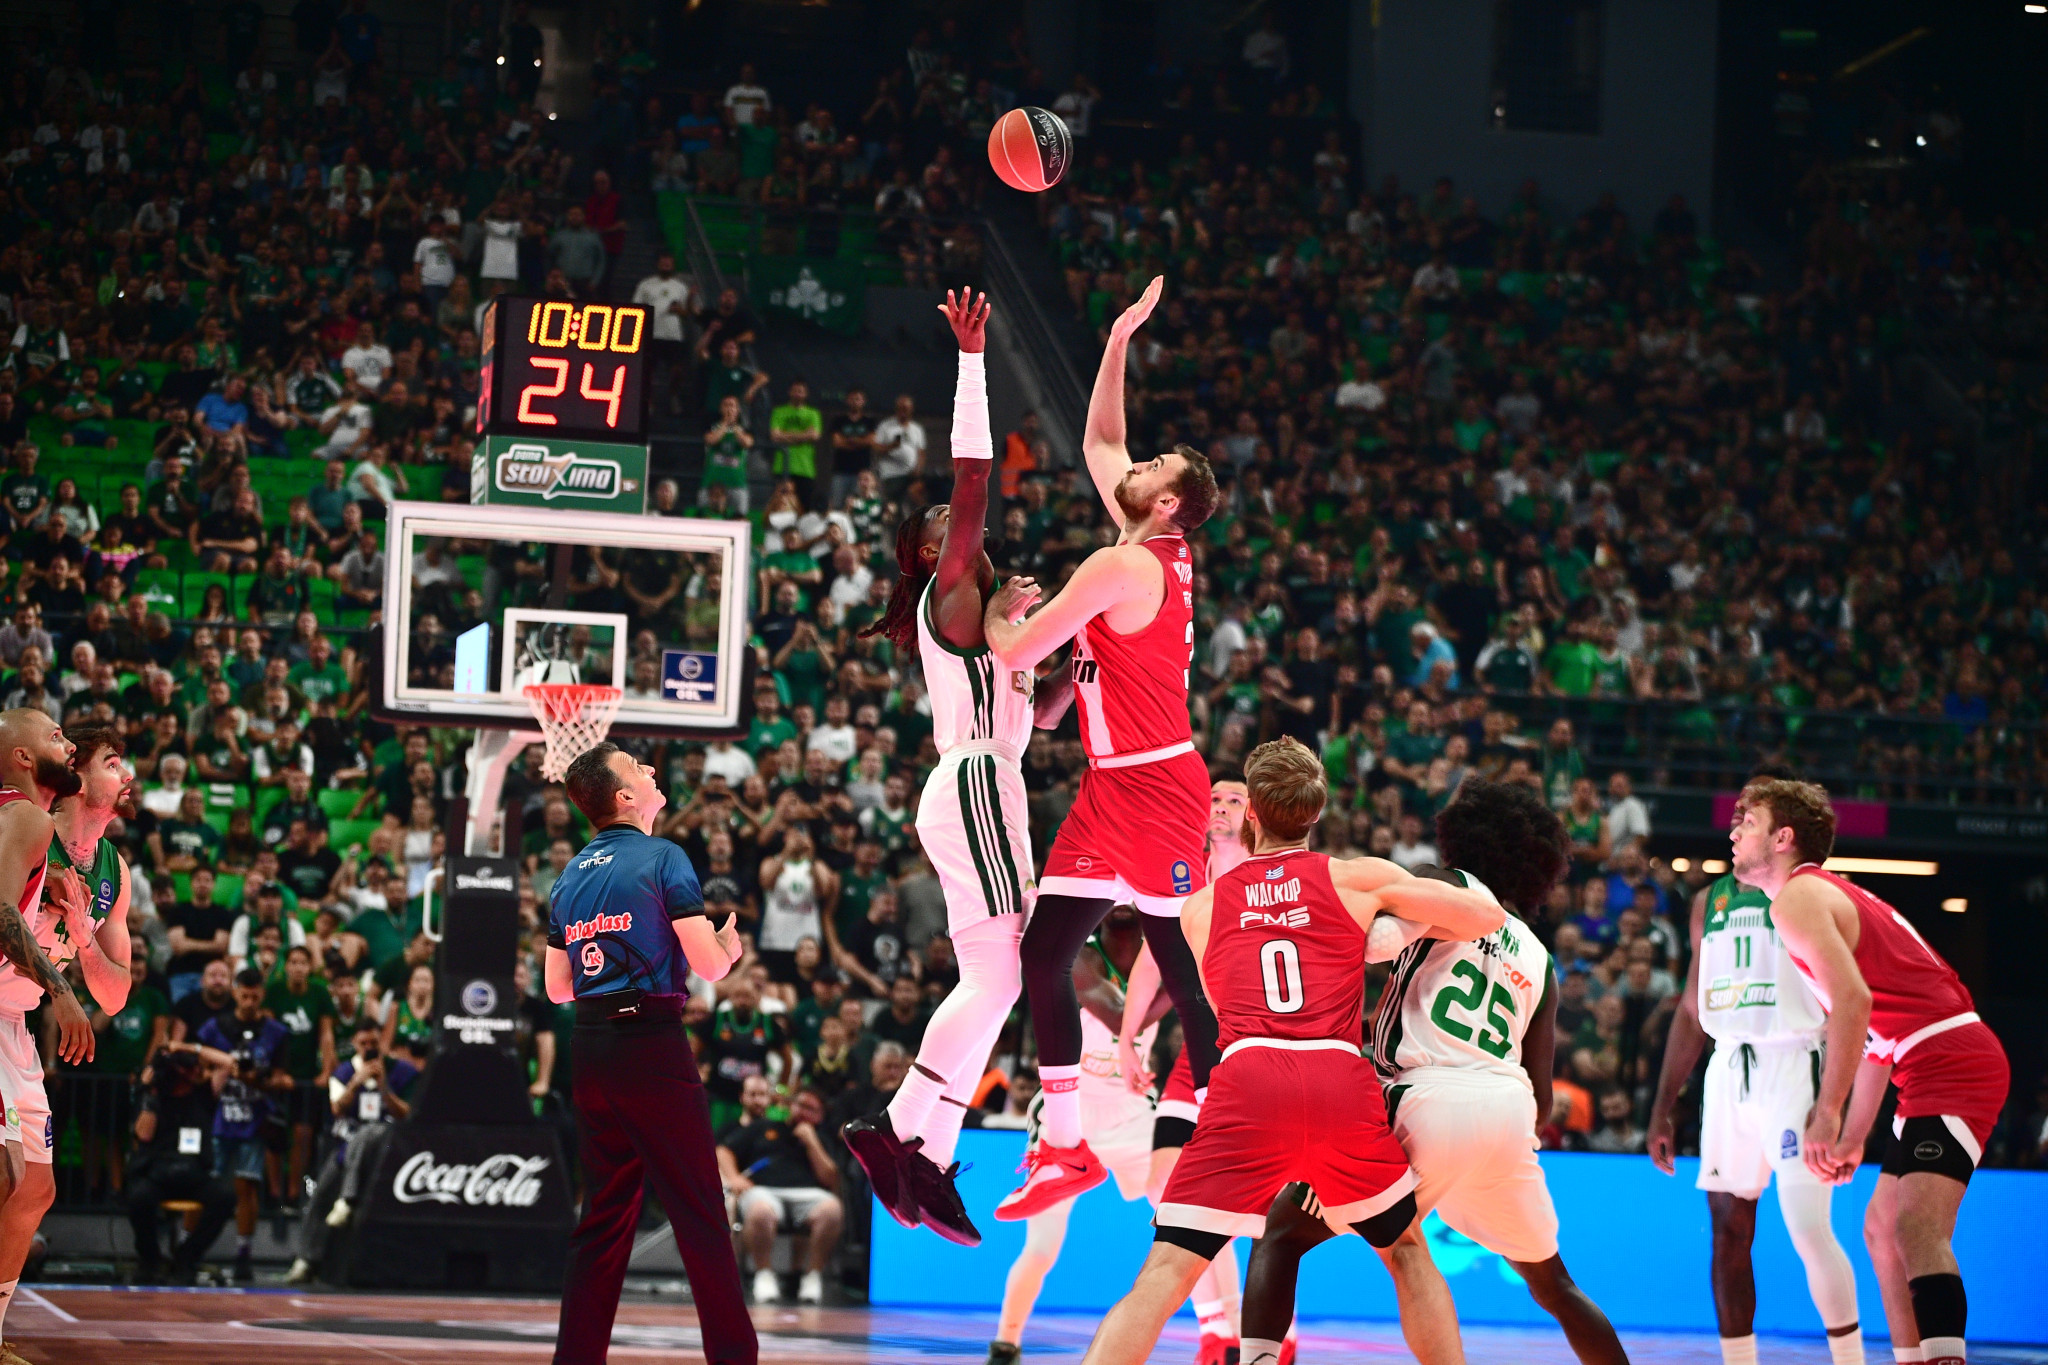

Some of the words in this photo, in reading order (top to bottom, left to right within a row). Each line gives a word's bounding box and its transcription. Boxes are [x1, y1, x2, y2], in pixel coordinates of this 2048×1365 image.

[527, 301, 646, 354] 10:00
[517, 356, 627, 429] 24
[1244, 877, 1302, 908] WALKUP
[1260, 938, 1305, 1014] 0
[1734, 935, 1751, 969] 11
[1430, 958, 1517, 1060] 25
